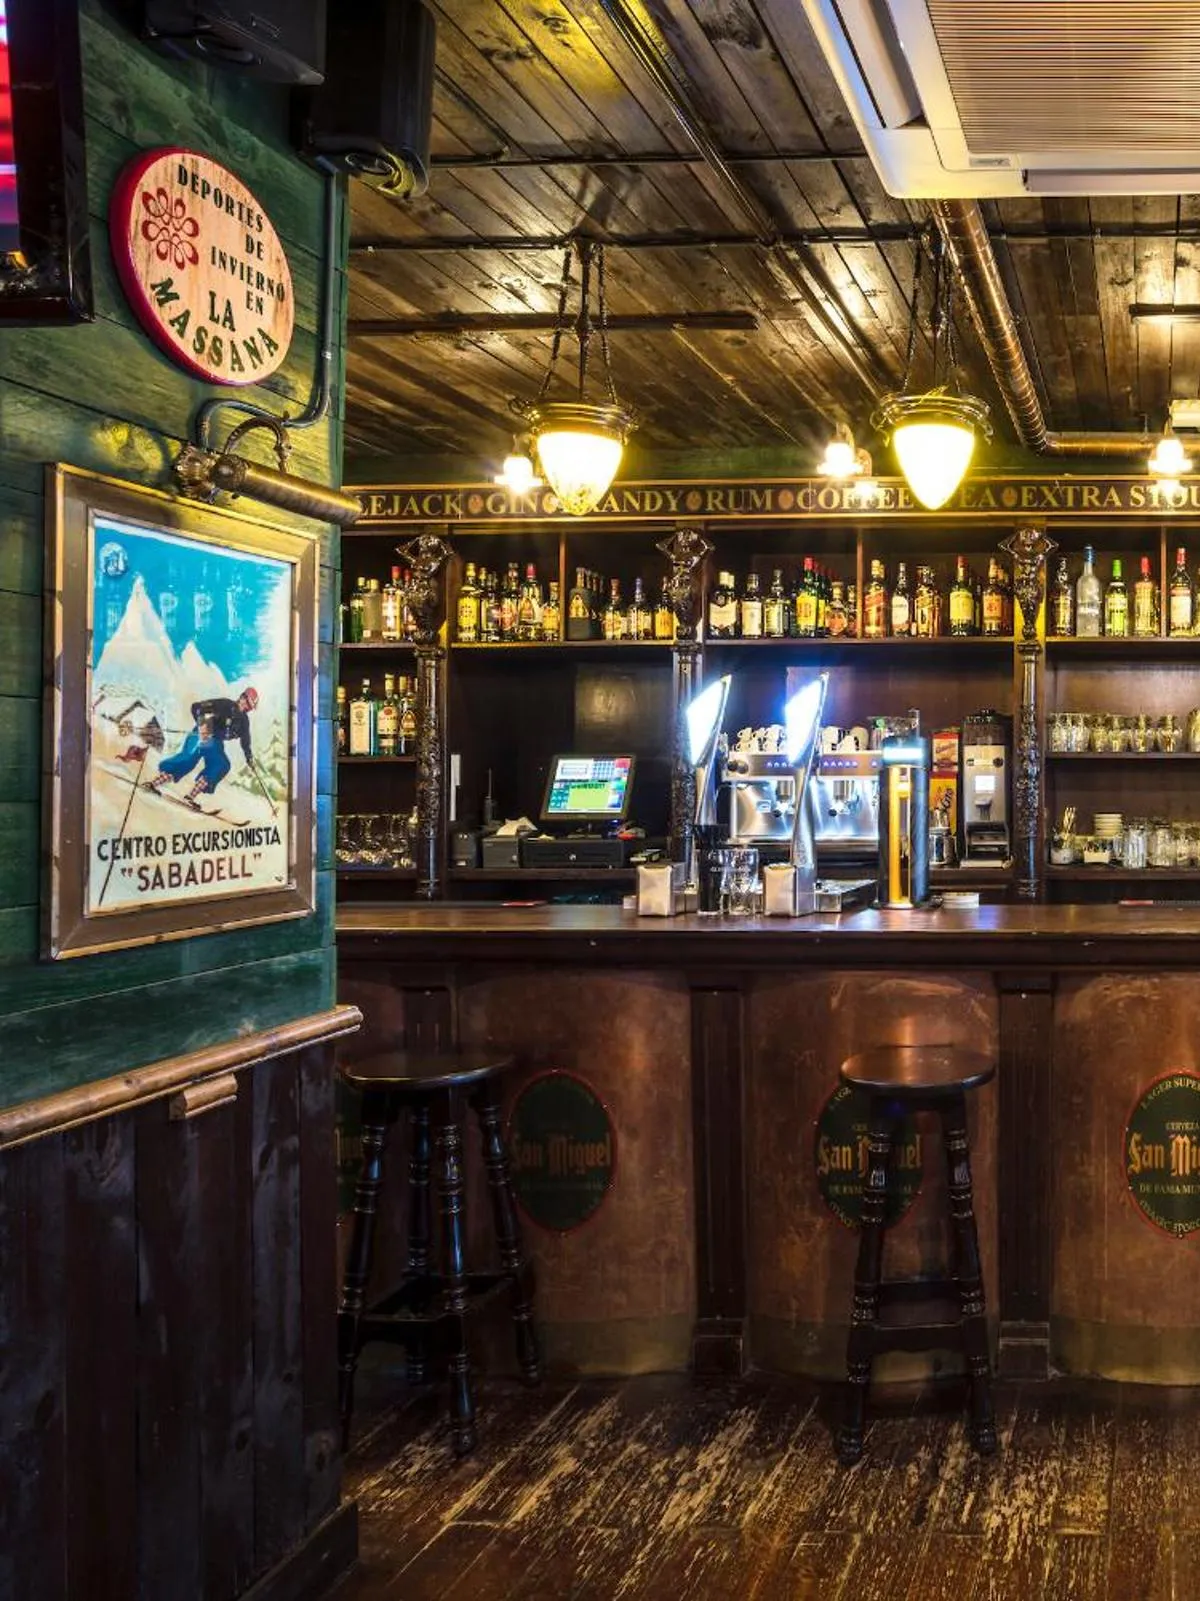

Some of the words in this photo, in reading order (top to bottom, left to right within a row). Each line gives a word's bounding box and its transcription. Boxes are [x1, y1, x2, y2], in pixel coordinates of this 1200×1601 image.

[177, 164, 263, 233] DEPORTES
[245, 234, 264, 261] DE
[211, 245, 285, 301] INVIERNO
[208, 290, 236, 333] LA
[246, 290, 263, 316] EN
[150, 277, 279, 373] MASSANA
[485, 492, 542, 514] GIN
[705, 489, 773, 511] RUM
[796, 490, 914, 511] COFFEE
[944, 486, 998, 508] EA
[1021, 485, 1121, 508] EXTRA
[97, 836, 167, 861] CENTRO
[172, 825, 281, 855] EXCURSIONISTA
[817, 1134, 852, 1175] San
[1127, 1131, 1165, 1175] San
